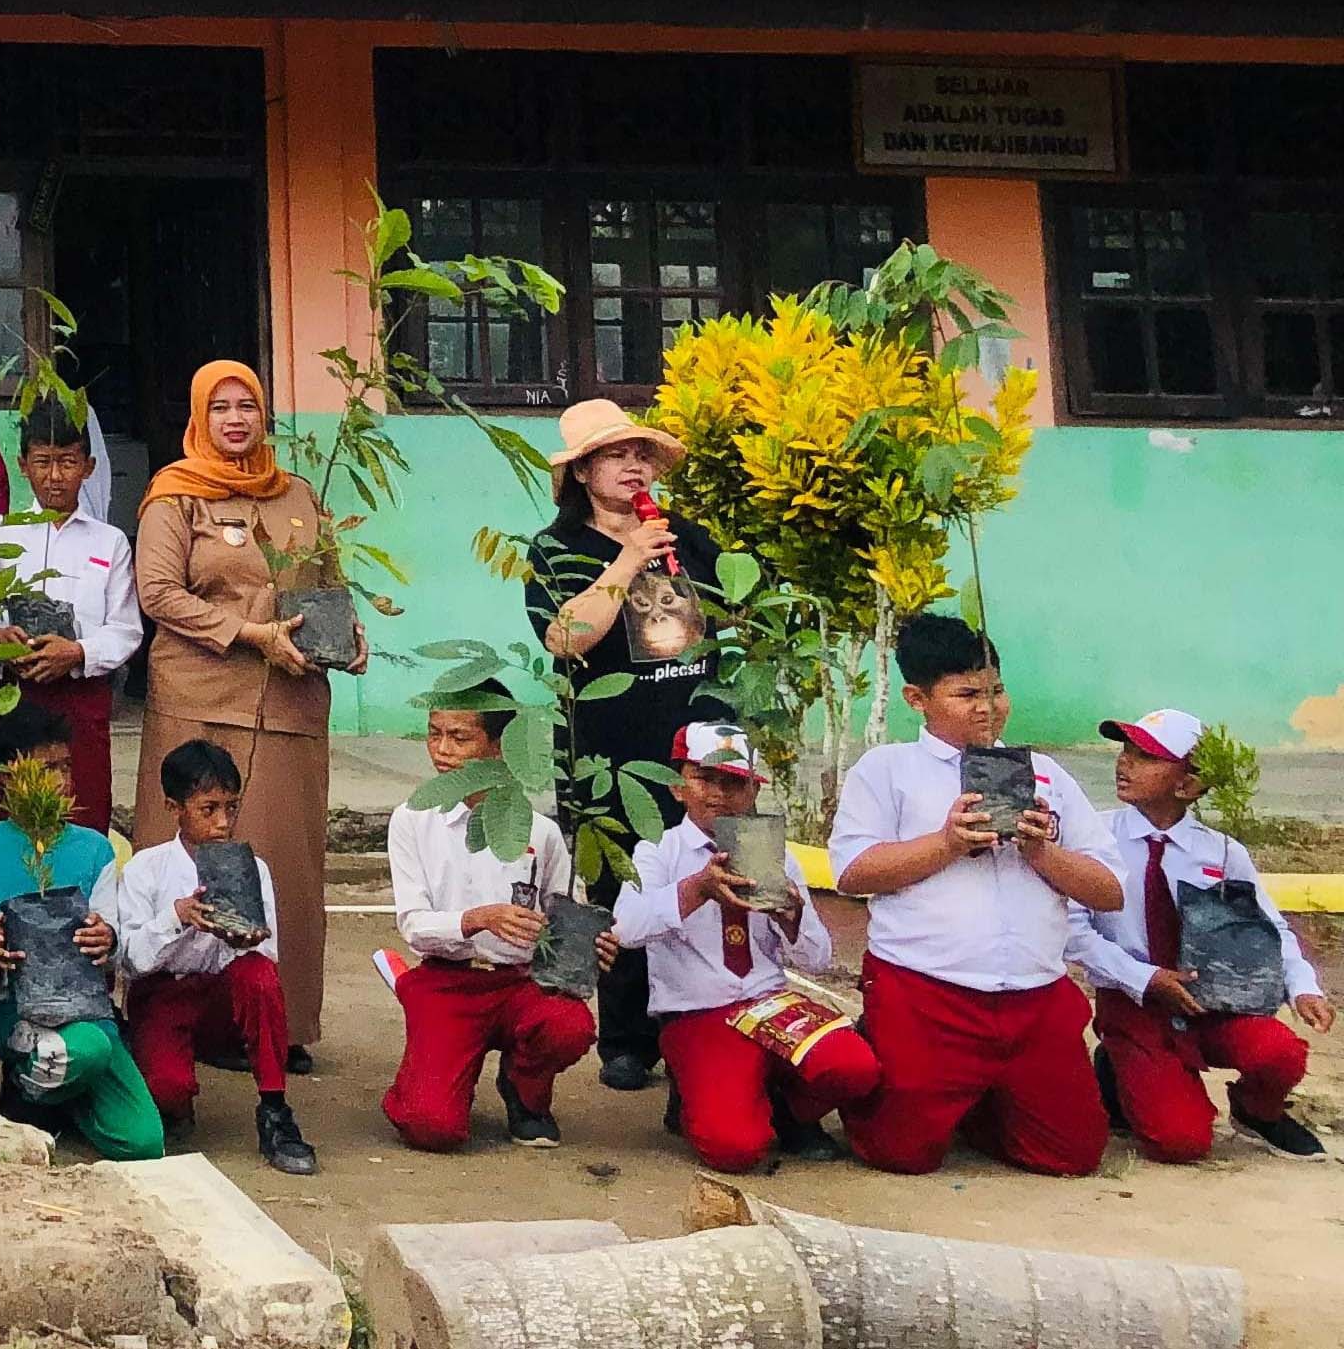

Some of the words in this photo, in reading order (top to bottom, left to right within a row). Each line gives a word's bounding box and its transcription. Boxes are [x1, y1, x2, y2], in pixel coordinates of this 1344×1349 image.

[936, 75, 1031, 96] BELAJAR
[903, 104, 987, 124] ADALAH
[992, 106, 1065, 127] TUGAS
[883, 131, 927, 151] DAN
[525, 389, 553, 405] NIA
